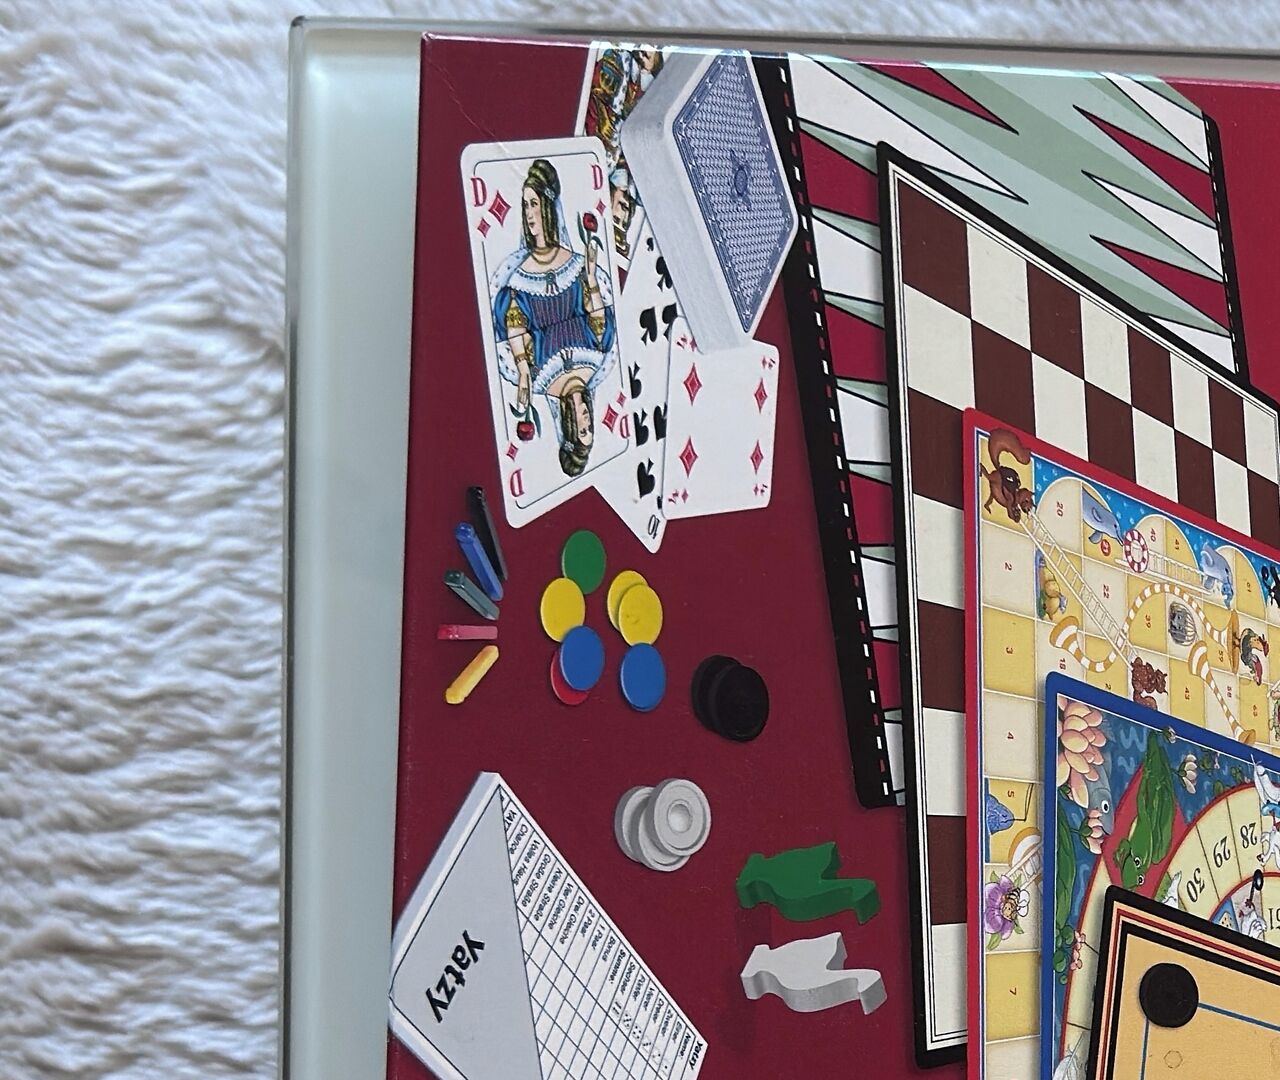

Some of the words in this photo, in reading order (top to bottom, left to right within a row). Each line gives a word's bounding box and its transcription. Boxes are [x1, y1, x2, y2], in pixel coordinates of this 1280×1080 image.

[470, 177, 488, 208] D
[509, 823, 528, 854] Chance
[1240, 822, 1257, 849] 28
[1213, 836, 1231, 868] 29
[1186, 867, 1205, 903] 30
[424, 929, 485, 1023] Yatzy
[688, 1041, 703, 1070] Yatzy
